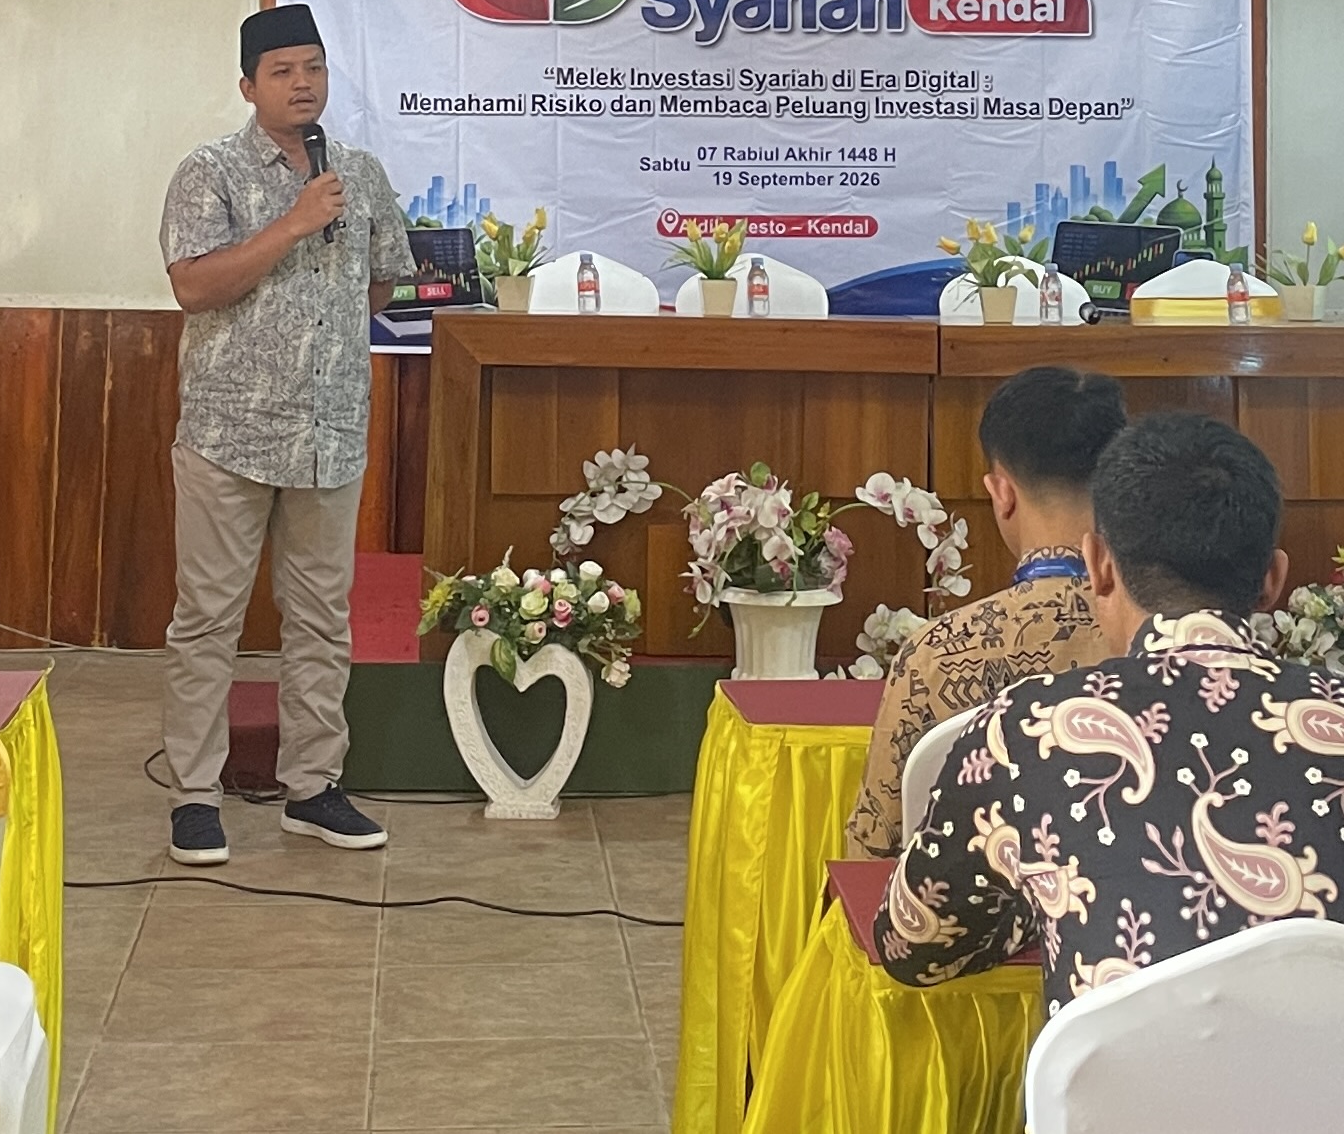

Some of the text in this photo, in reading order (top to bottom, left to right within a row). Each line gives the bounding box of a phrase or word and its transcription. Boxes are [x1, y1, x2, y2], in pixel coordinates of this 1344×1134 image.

[630, 68, 732, 88] Investasi
[739, 69, 824, 93] Syariah
[832, 69, 853, 88] di
[860, 70, 898, 88] Era
[905, 70, 977, 94] Digital
[399, 93, 525, 113] Memahami
[531, 94, 603, 114] Risiko
[610, 95, 652, 114] dan
[660, 96, 768, 115] Membaca
[776, 96, 867, 120] Peluang
[875, 97, 976, 116] Investasi
[984, 98, 1041, 116] Masa
[697, 146, 896, 162] 07 Rabiul Akhir 1448 H
[639, 157, 691, 172] Sabtu
[713, 171, 881, 189] 19 September 2026
[808, 220, 869, 235] Kendal
[427, 286, 446, 297] SELL
[1092, 284, 1113, 295] BUY
